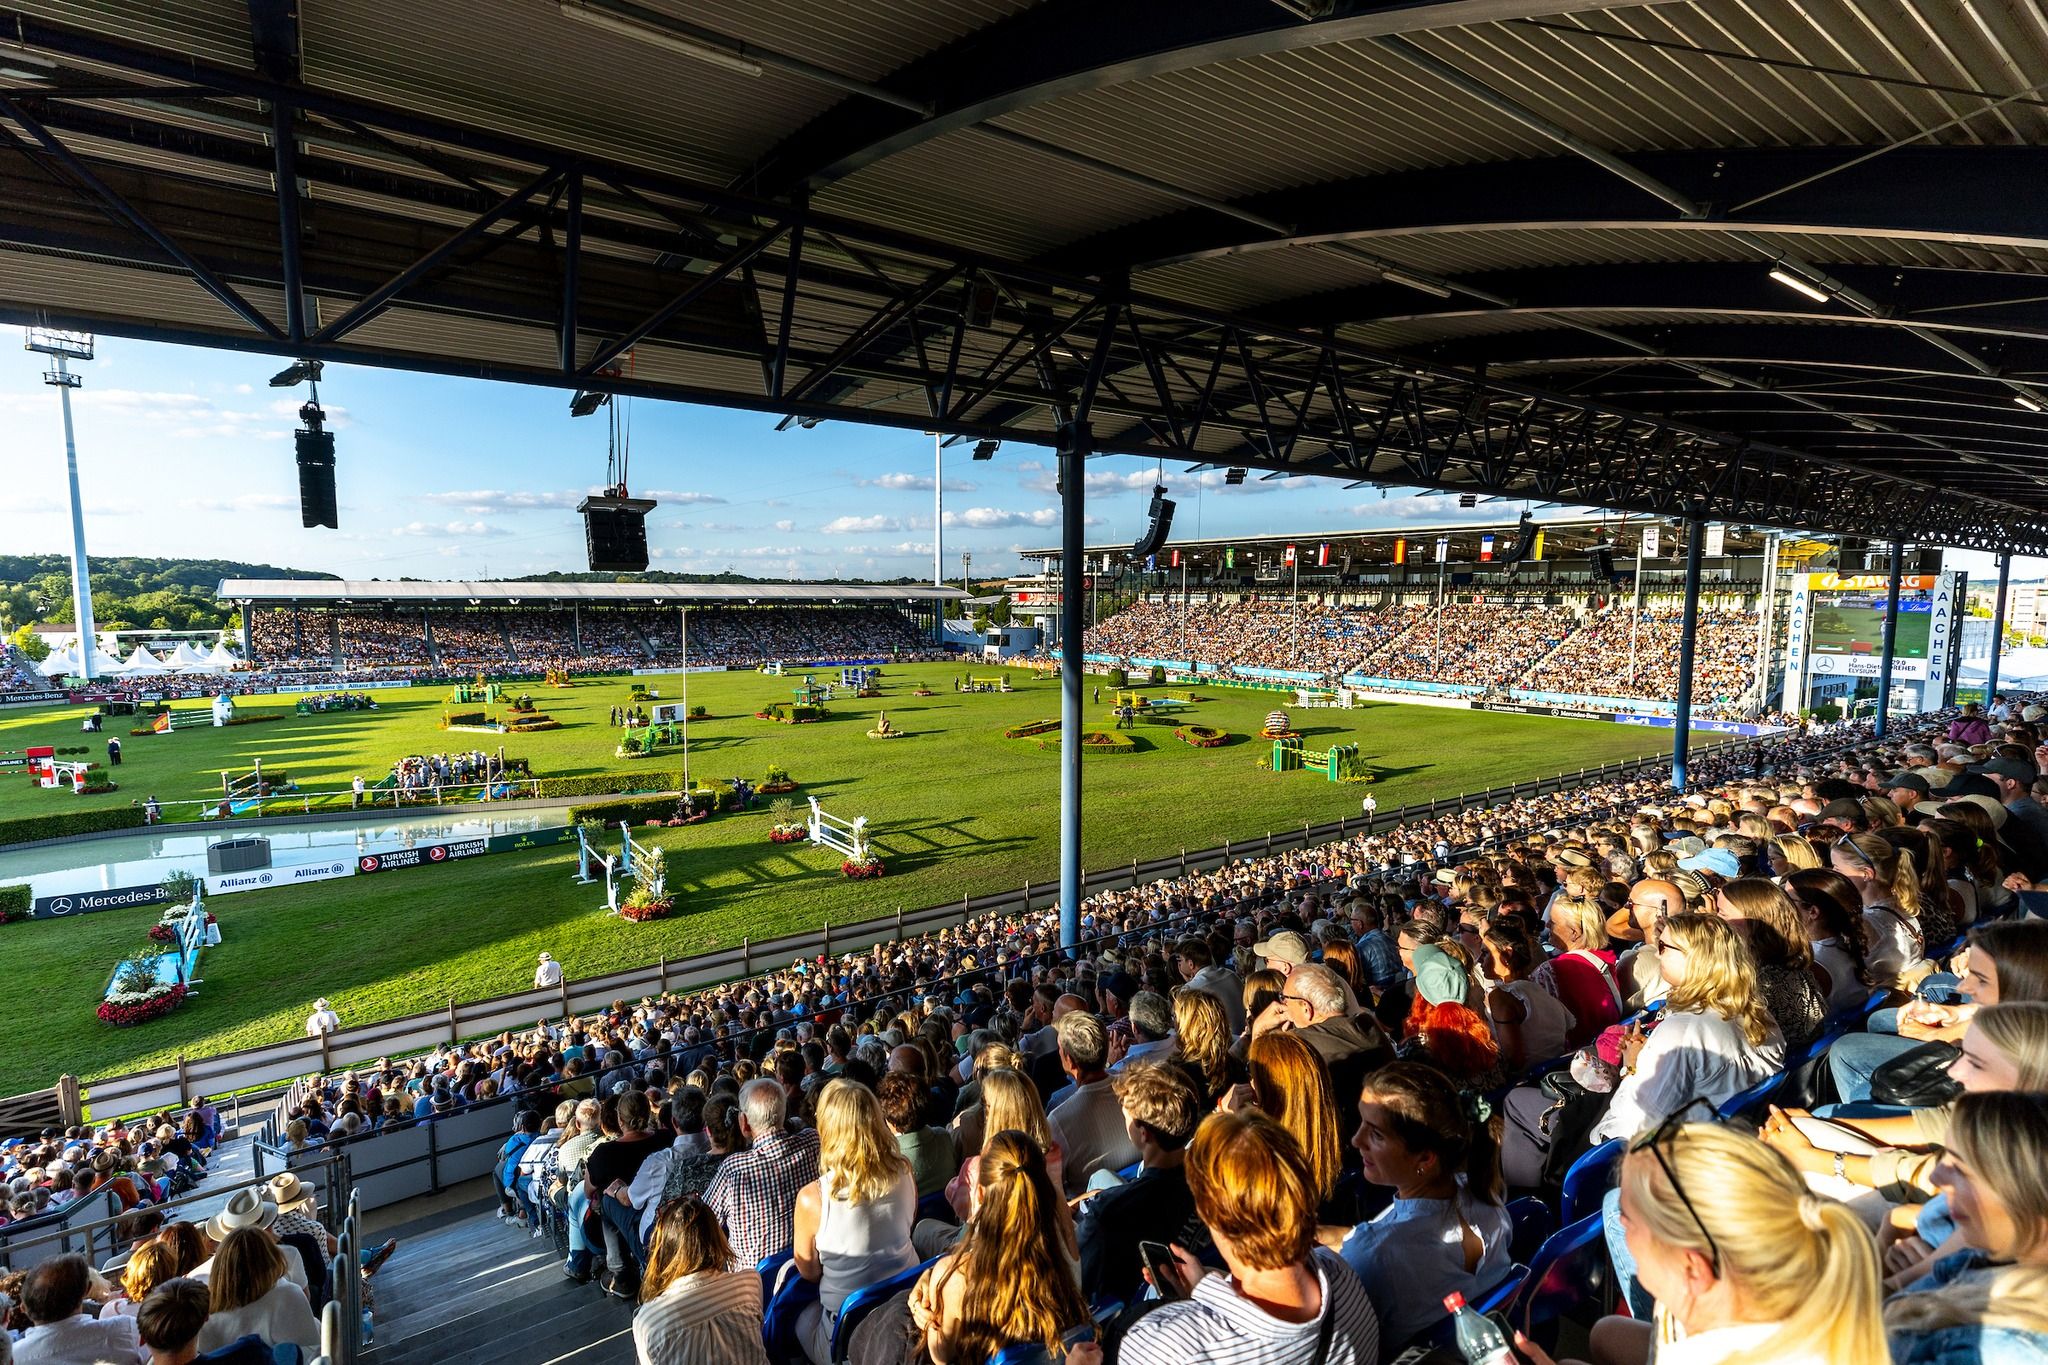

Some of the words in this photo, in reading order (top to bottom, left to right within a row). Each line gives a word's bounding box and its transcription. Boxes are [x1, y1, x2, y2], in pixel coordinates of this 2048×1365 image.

[1790, 591, 1804, 671] AACHEN
[1930, 591, 1949, 680] AACHEN
[5, 692, 64, 702] Mercedes-Benz
[1560, 711, 1600, 719] Mercedes-Benz
[448, 840, 484, 852] TURKISH
[514, 840, 536, 848] ROLEX
[381, 850, 419, 862] TURKISH
[448, 847, 485, 858] AIRLINES
[381, 857, 420, 868] AIRLINES
[295, 867, 329, 878] Allianz
[220, 877, 257, 888] Allianz
